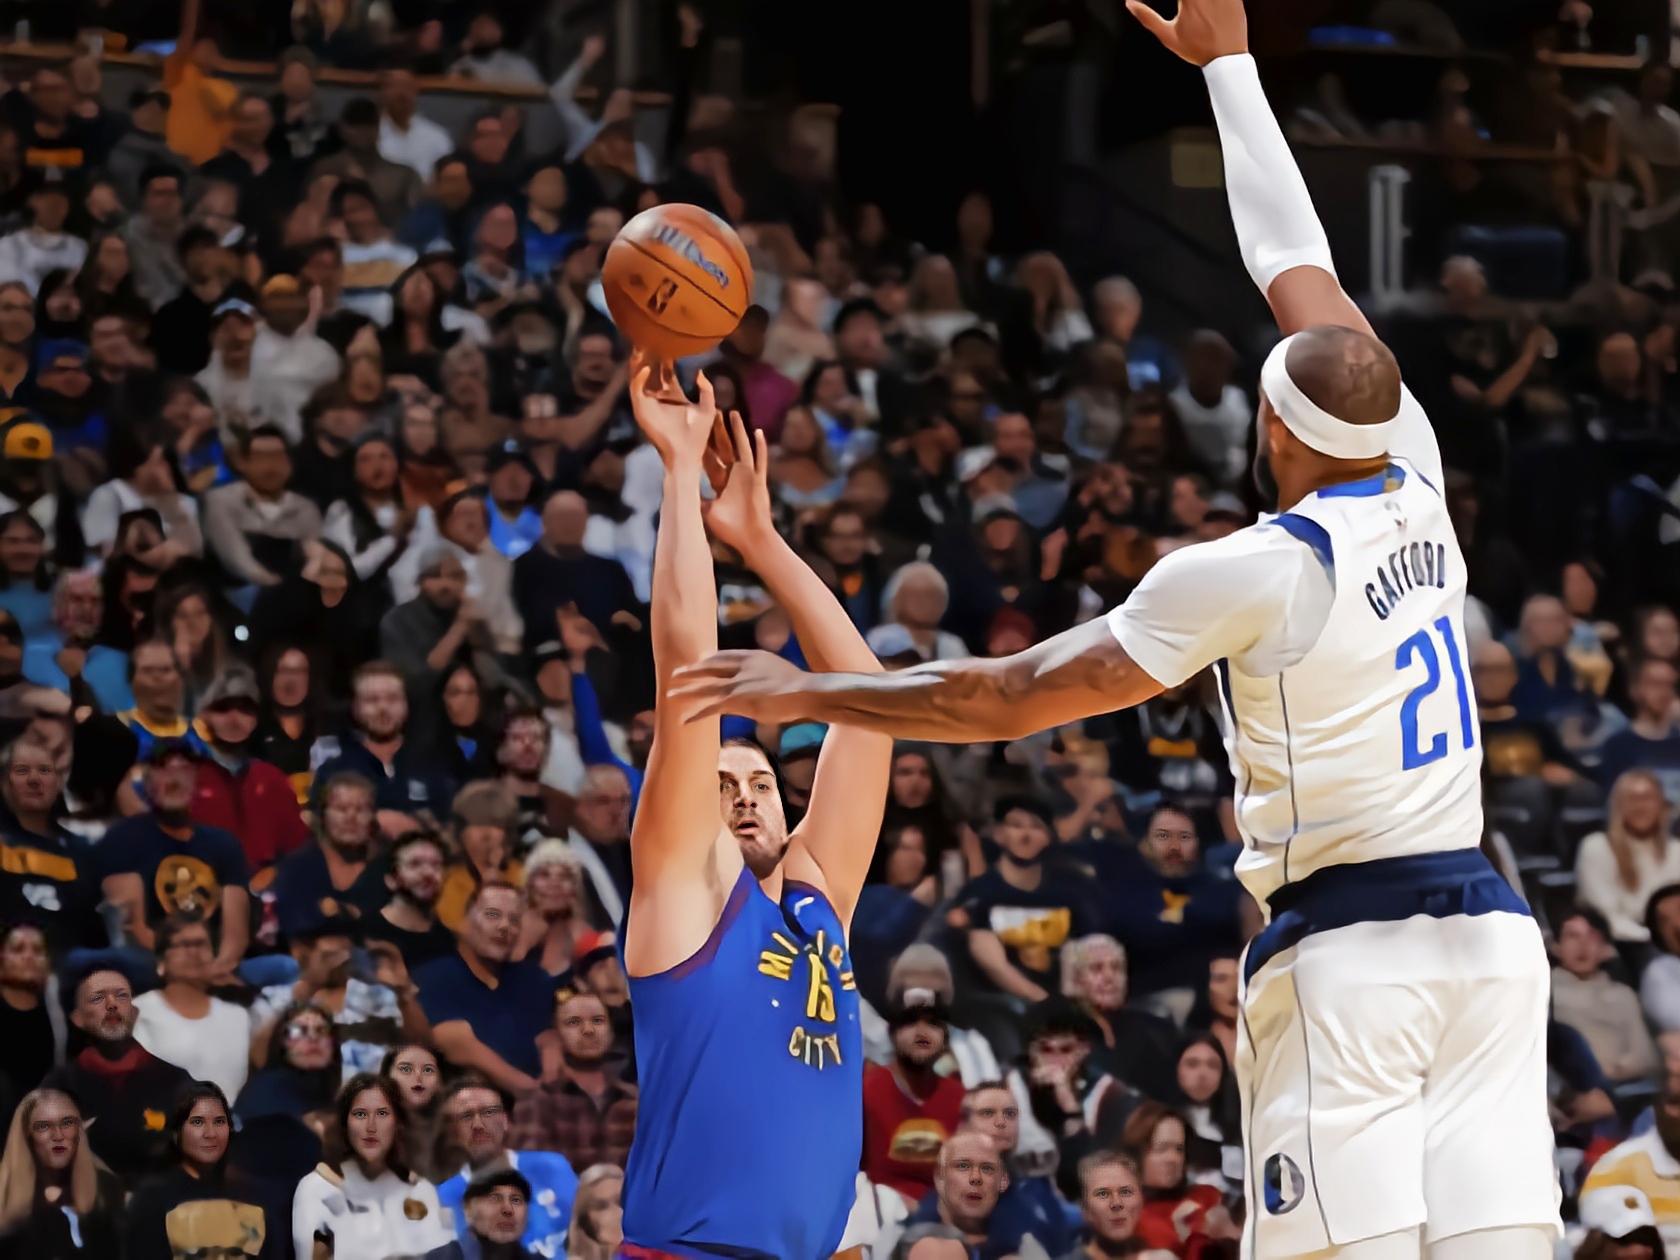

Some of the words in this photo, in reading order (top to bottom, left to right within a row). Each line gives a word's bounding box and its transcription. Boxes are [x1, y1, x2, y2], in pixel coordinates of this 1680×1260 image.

[1395, 615, 1474, 770] 21
[806, 953, 836, 1022] 15
[789, 1026, 842, 1071] CITY
